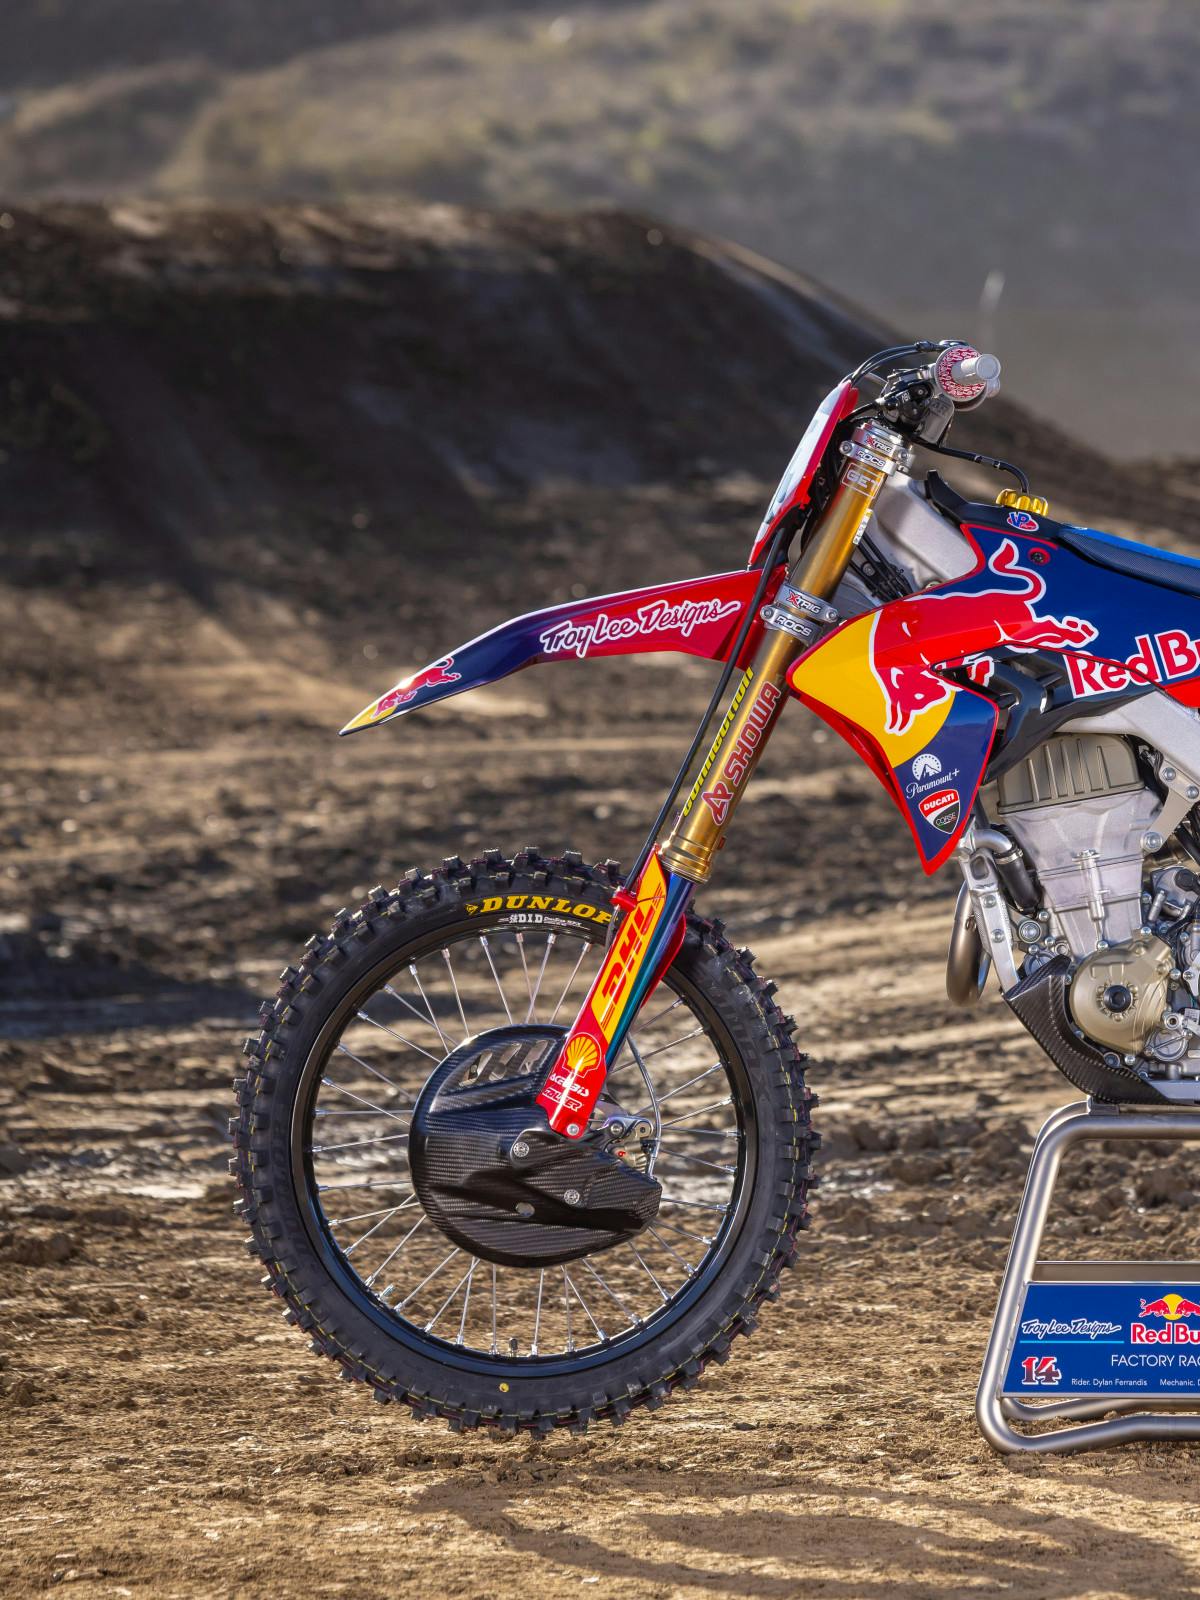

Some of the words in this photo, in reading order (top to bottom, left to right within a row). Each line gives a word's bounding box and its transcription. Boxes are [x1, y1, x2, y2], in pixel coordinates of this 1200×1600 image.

[855, 450, 886, 467] ROCS
[788, 588, 821, 615] XTRIG
[540, 620, 595, 658] Troy
[591, 614, 638, 644] Lee
[637, 599, 741, 637] Designs
[774, 614, 813, 637] ROCS
[1062, 632, 1163, 699] Red
[722, 681, 782, 787] SHOWA
[906, 768, 960, 799] Paramount+
[923, 793, 955, 811] DUCATI
[601, 904, 657, 1003] DHL
[549, 1072, 590, 1097] ACEBIS
[542, 1086, 583, 1113] GALER
[1021, 1318, 1048, 1341] Troy
[1046, 1319, 1071, 1334] Lee
[1070, 1318, 1123, 1341] Designs
[1130, 1322, 1172, 1345] Red
[1021, 1356, 1062, 1386] 14
[1111, 1354, 1175, 1368] FACTORY
[1092, 1378, 1113, 1388] Dylan
[1114, 1378, 1148, 1387] Ferrandis
